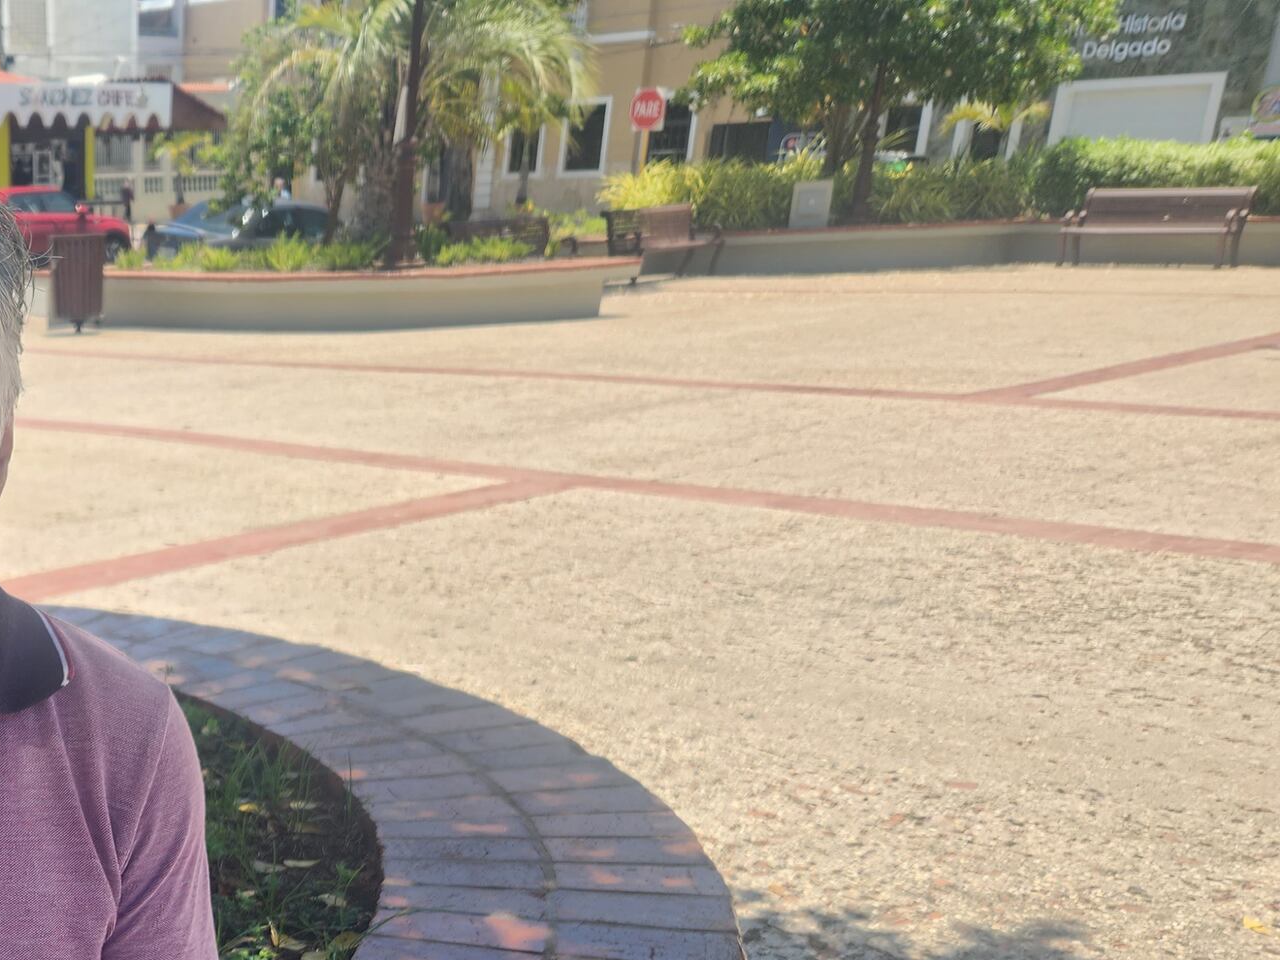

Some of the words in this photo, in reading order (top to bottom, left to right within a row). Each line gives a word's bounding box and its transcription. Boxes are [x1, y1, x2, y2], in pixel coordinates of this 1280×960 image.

[1119, 12, 1187, 33] Historia
[1082, 37, 1171, 62] Delgado
[633, 100, 660, 117] PARE
